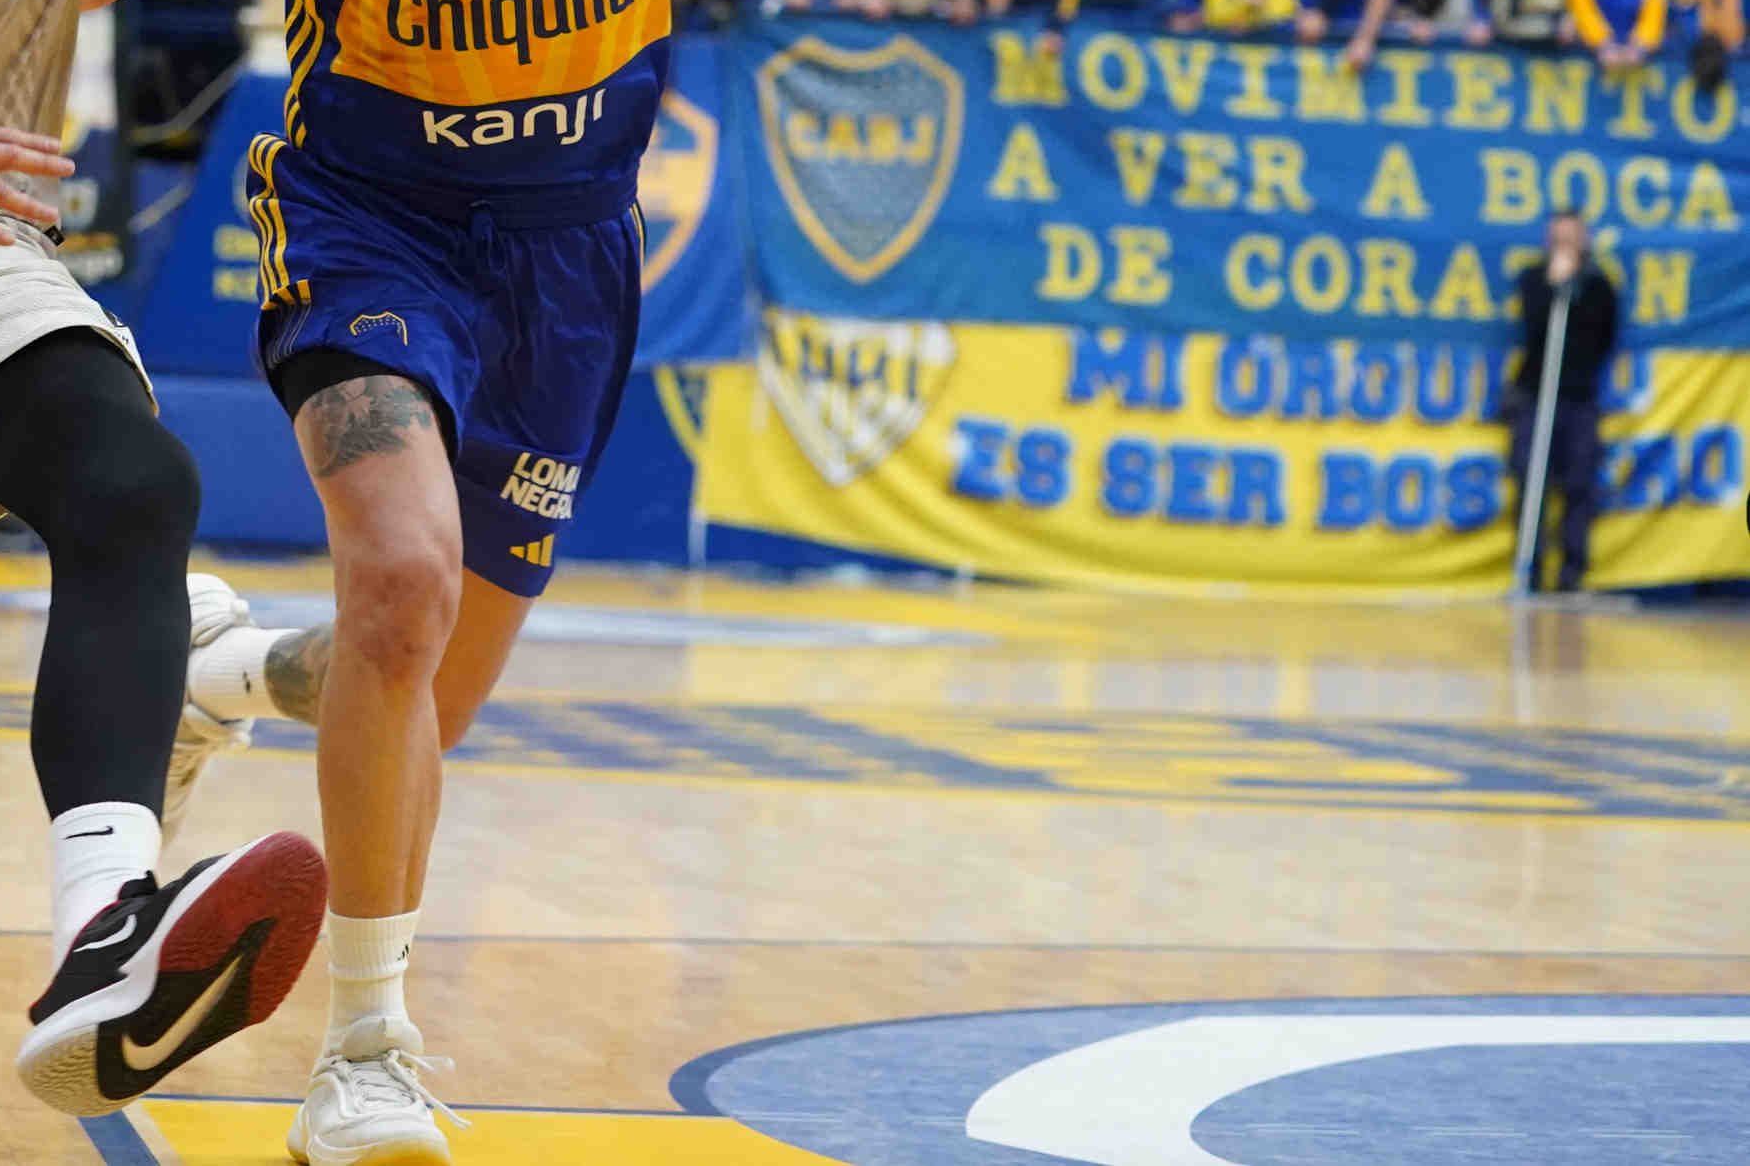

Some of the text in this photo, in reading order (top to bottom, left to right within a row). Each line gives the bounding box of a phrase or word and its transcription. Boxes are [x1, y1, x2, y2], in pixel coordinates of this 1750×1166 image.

[989, 31, 1738, 144] MOVIMIENTO
[787, 111, 935, 165] CABJ
[988, 121, 1742, 233] A VER A BOCA
[1036, 222, 1174, 308] DE
[1066, 327, 1184, 411] MI
[951, 416, 1073, 506] ES
[1102, 436, 1288, 528] SER
